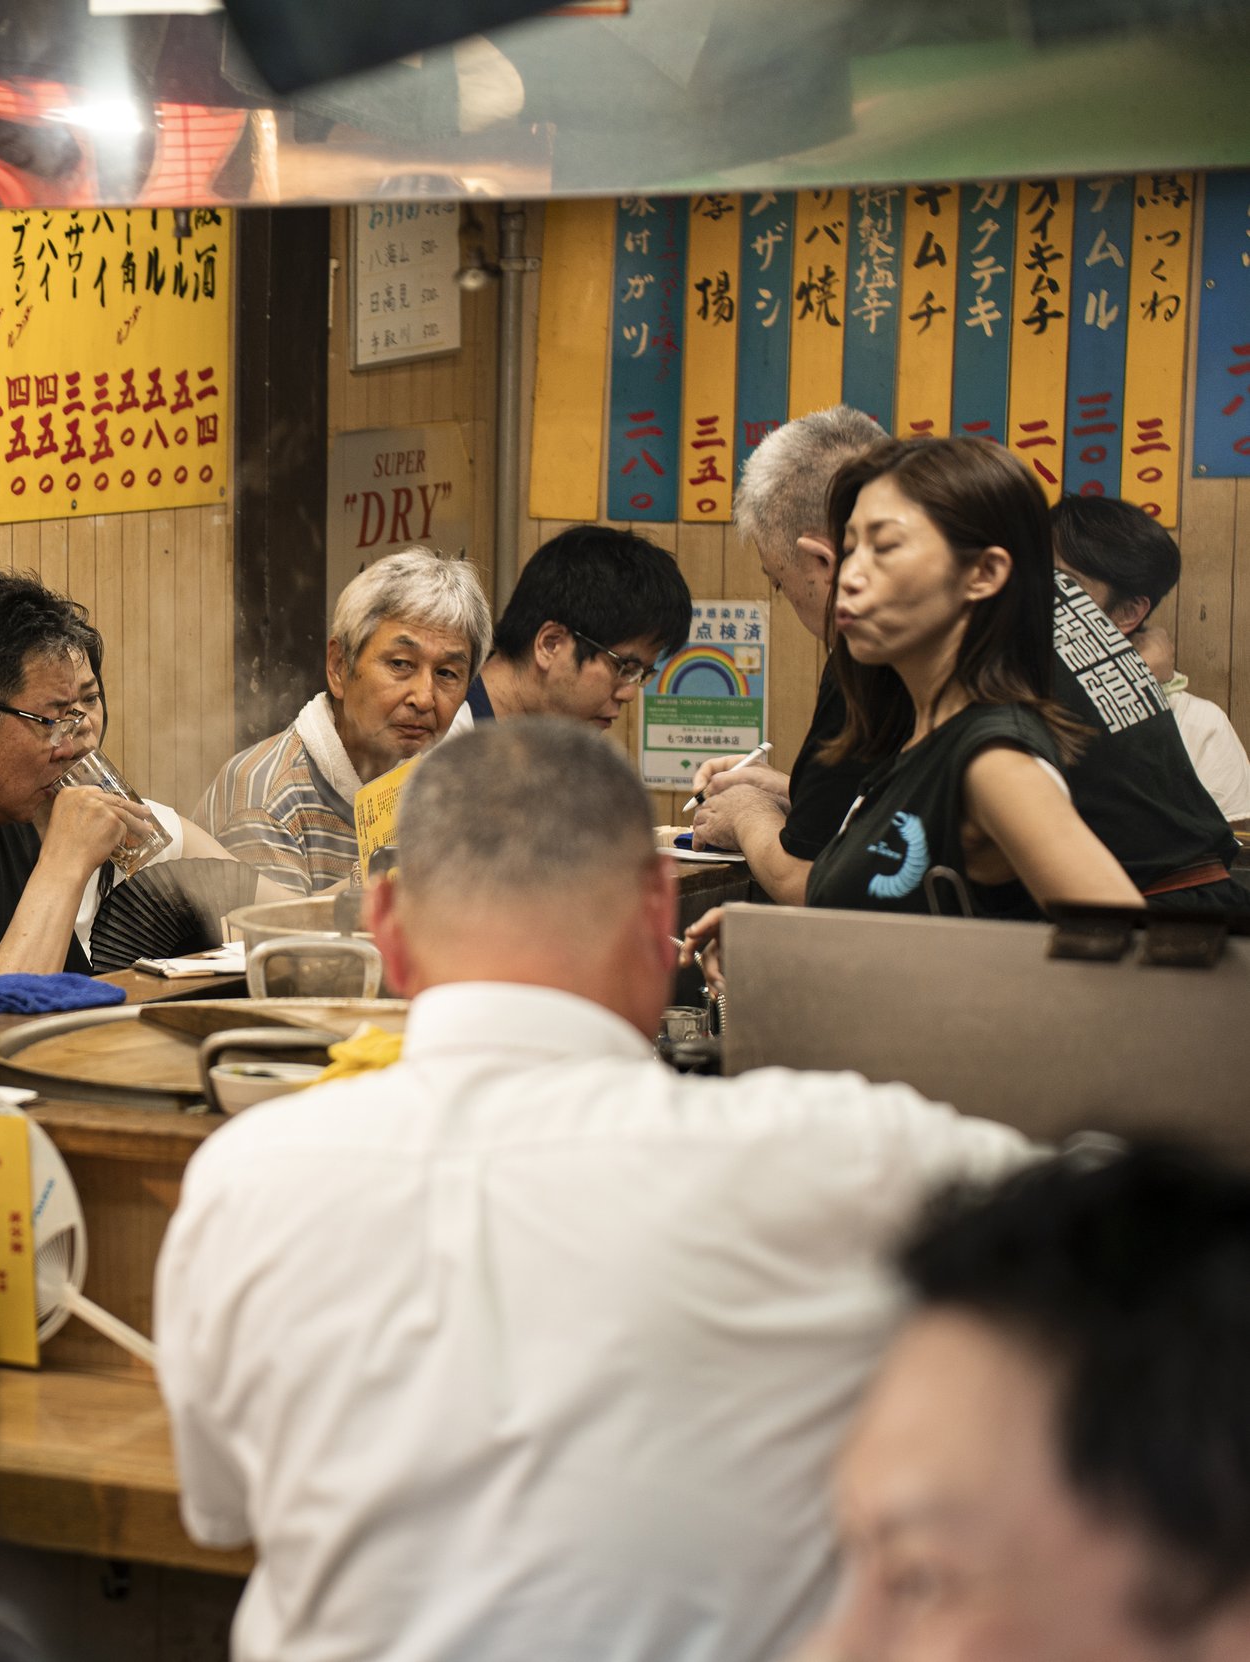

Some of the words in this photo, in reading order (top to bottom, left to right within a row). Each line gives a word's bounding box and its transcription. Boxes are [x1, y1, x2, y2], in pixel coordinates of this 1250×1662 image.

[11, 211, 31, 307] ブラン
[65, 210, 85, 299] サワー
[121, 209, 136, 295] ー角
[5, 374, 31, 495] 四五〇
[33, 373, 59, 493] 四五〇
[60, 371, 86, 491] 三五〇
[89, 372, 114, 491] 三五〇
[115, 368, 140, 488] 五〇〇
[142, 367, 169, 486] 五八〇
[170, 369, 194, 484] 五〇〇
[196, 367, 218, 483] 二四〇
[374, 449, 426, 478] SUPER
[621, 411, 664, 509] 二八〇
[689, 416, 726, 513] 三五〇
